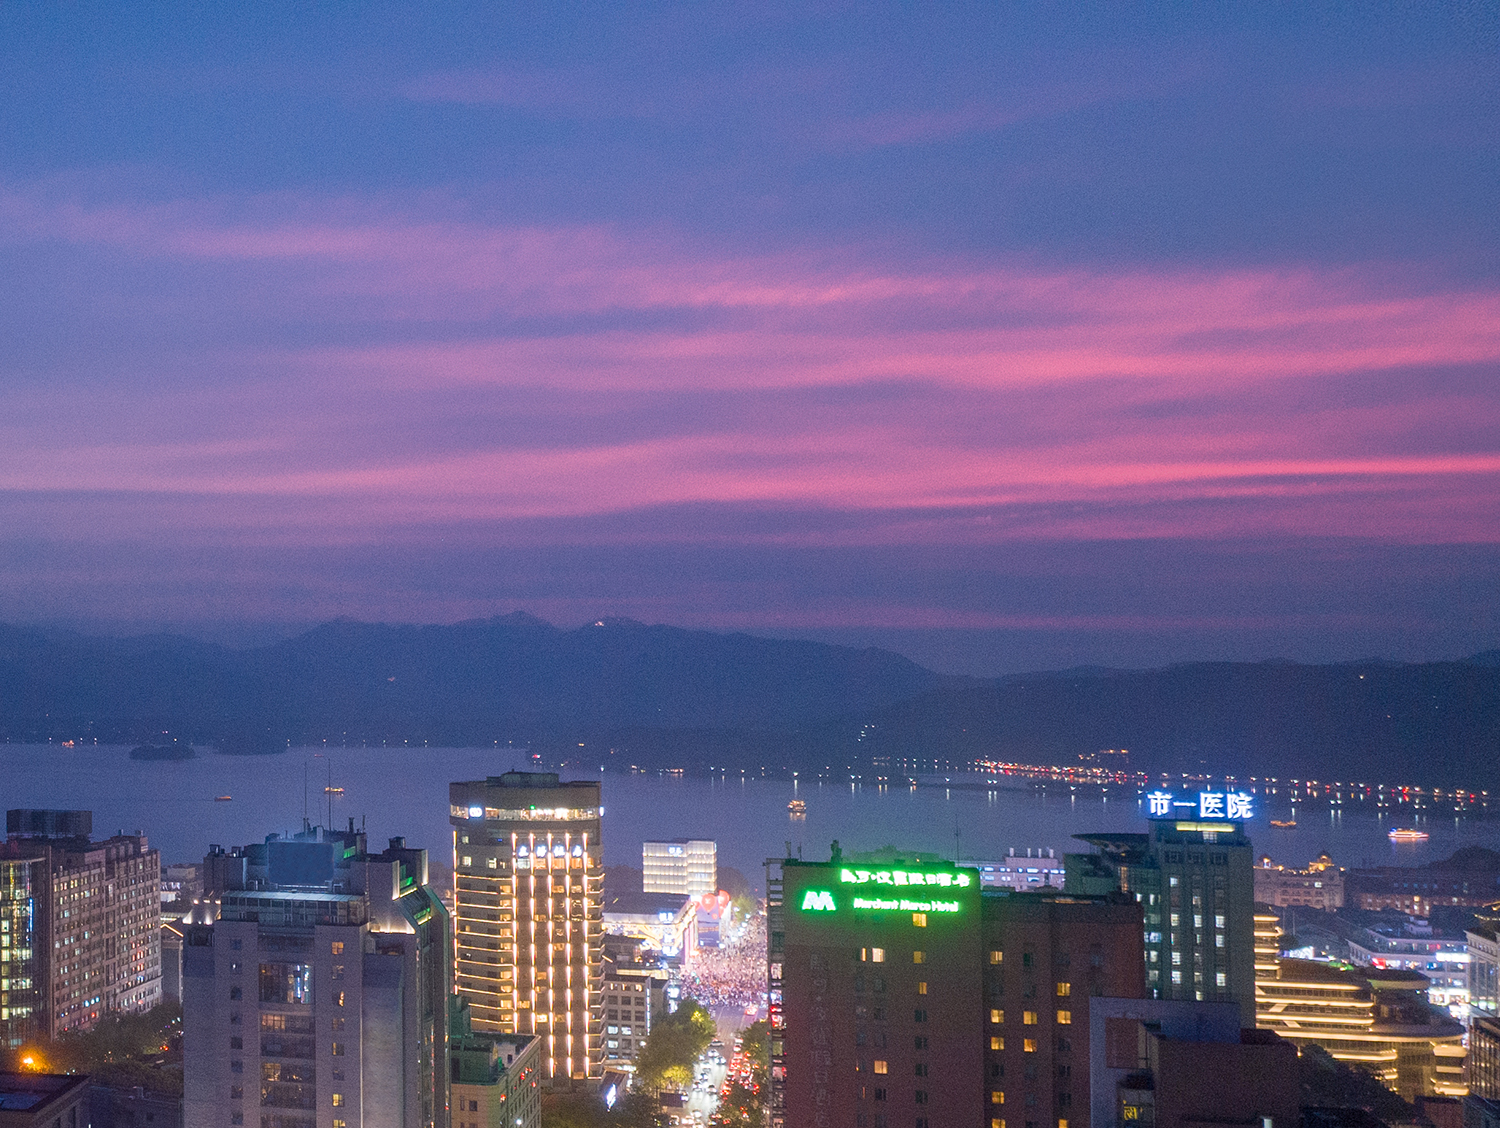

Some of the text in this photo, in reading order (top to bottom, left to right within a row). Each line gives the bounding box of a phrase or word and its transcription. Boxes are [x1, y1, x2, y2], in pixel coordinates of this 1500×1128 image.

[1147, 791, 1254, 819] 市一医院
[853, 898, 959, 912] Merchant Marco Hotel
